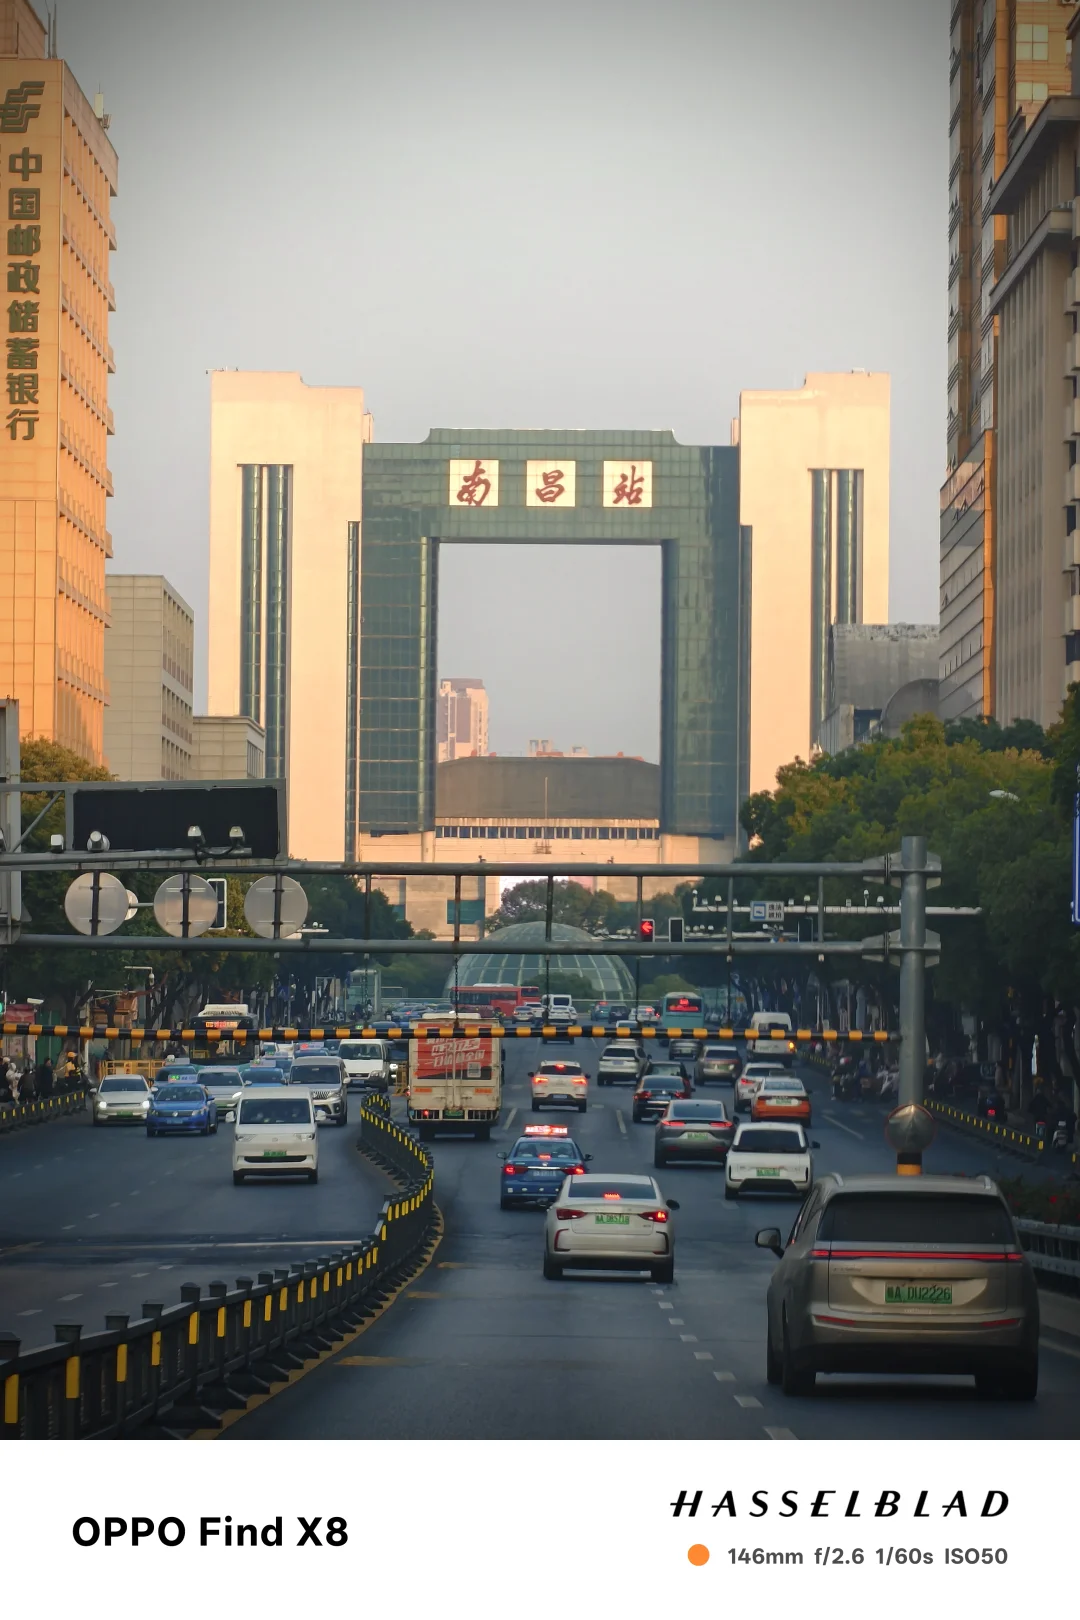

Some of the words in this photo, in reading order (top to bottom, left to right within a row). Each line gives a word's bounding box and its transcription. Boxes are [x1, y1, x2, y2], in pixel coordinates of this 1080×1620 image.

[6, 146, 43, 441] 中国邮政储蓄银行
[456, 460, 645, 507] 南昌站
